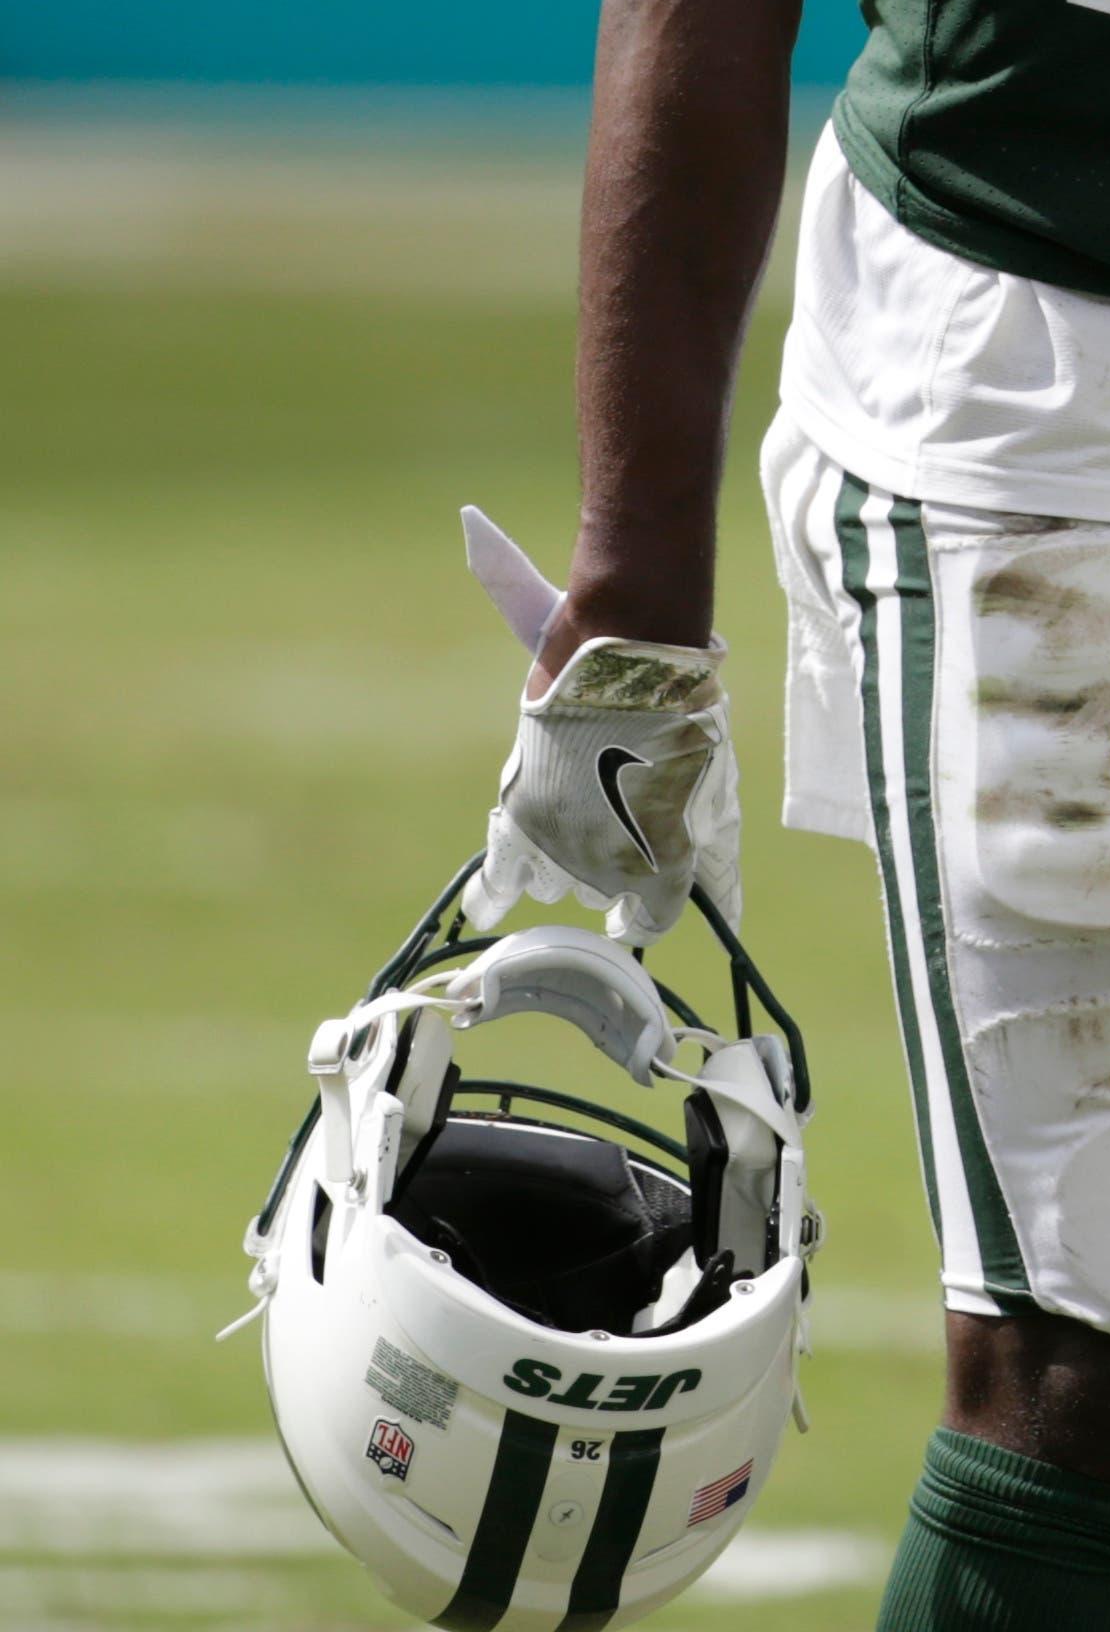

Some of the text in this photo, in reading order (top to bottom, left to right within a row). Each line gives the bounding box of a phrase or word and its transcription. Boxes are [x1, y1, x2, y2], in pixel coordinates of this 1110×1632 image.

[503, 1358, 702, 1412] JETS
[378, 1428, 411, 1463] NFL
[571, 1440, 603, 1460] 26
